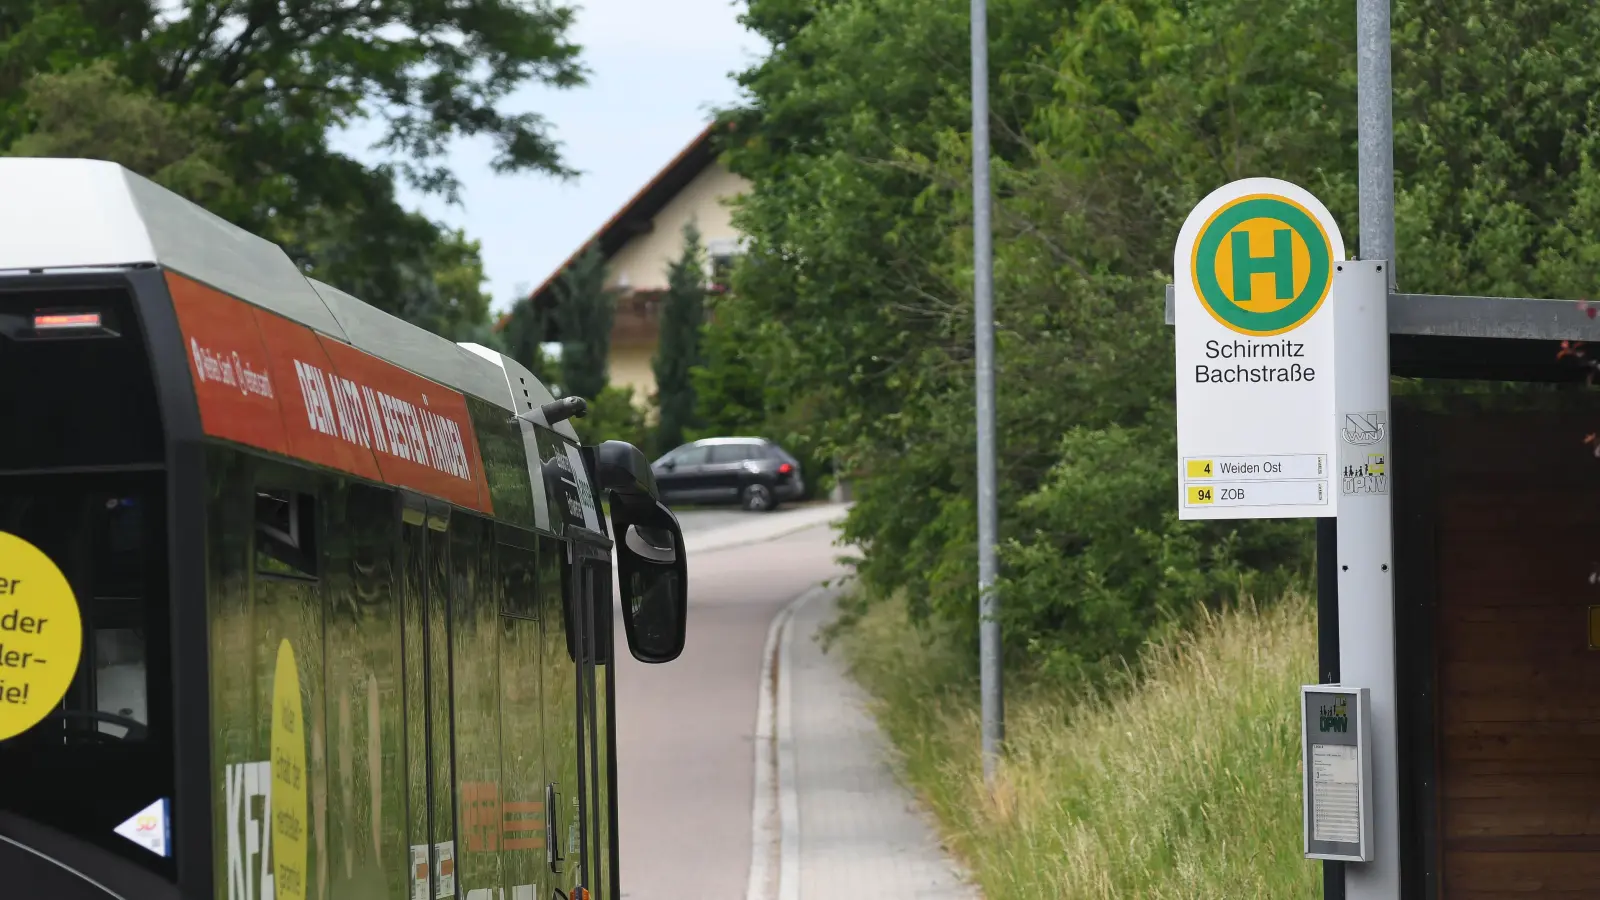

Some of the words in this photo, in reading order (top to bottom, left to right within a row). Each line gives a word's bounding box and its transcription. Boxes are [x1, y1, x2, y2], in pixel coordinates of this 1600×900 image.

[1231, 229, 1294, 301] H
[1205, 339, 1305, 359] Schirmitz
[1195, 363, 1316, 383] Bachstraße
[293, 358, 338, 437] DEIN
[329, 373, 371, 449] AUTO
[361, 384, 388, 453] IN
[377, 390, 430, 467] BESTEN
[418, 393, 471, 481] HÄNDEN
[1203, 463, 1211, 475] 4
[1220, 463, 1260, 474] Weiden
[1263, 461, 1282, 473] Ost
[1198, 489, 1212, 501] 94
[1220, 488, 1245, 500] ZOB
[0, 608, 48, 634] der
